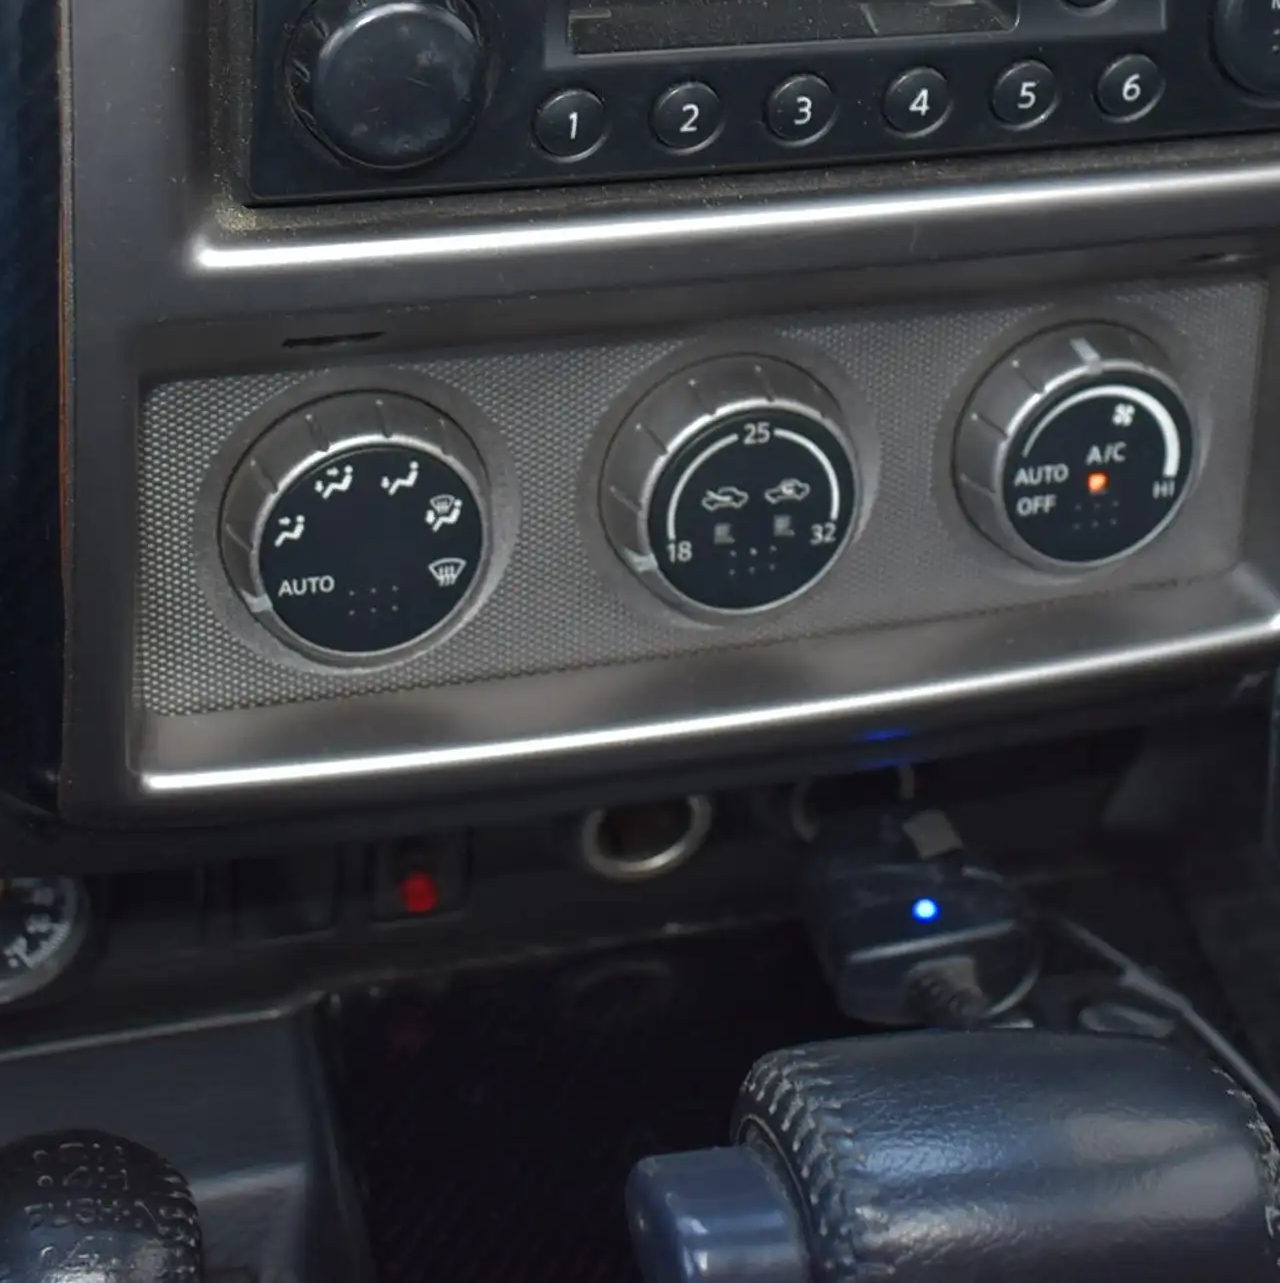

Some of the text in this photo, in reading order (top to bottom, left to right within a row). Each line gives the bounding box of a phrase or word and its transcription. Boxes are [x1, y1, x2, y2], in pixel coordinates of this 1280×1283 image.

[1018, 81, 1037, 109] 5
[1121, 73, 1142, 103] 6
[794, 96, 812, 125] 3
[909, 88, 930, 116] 4
[568, 111, 578, 139] 1
[679, 103, 700, 133] 2
[743, 421, 772, 445] 25
[1086, 441, 1127, 465] A/C
[1013, 463, 1069, 487] AUTO
[1016, 494, 1056, 517] OFF
[810, 522, 837, 546] 32
[667, 540, 693, 564] 18
[278, 574, 335, 597] AUTO
